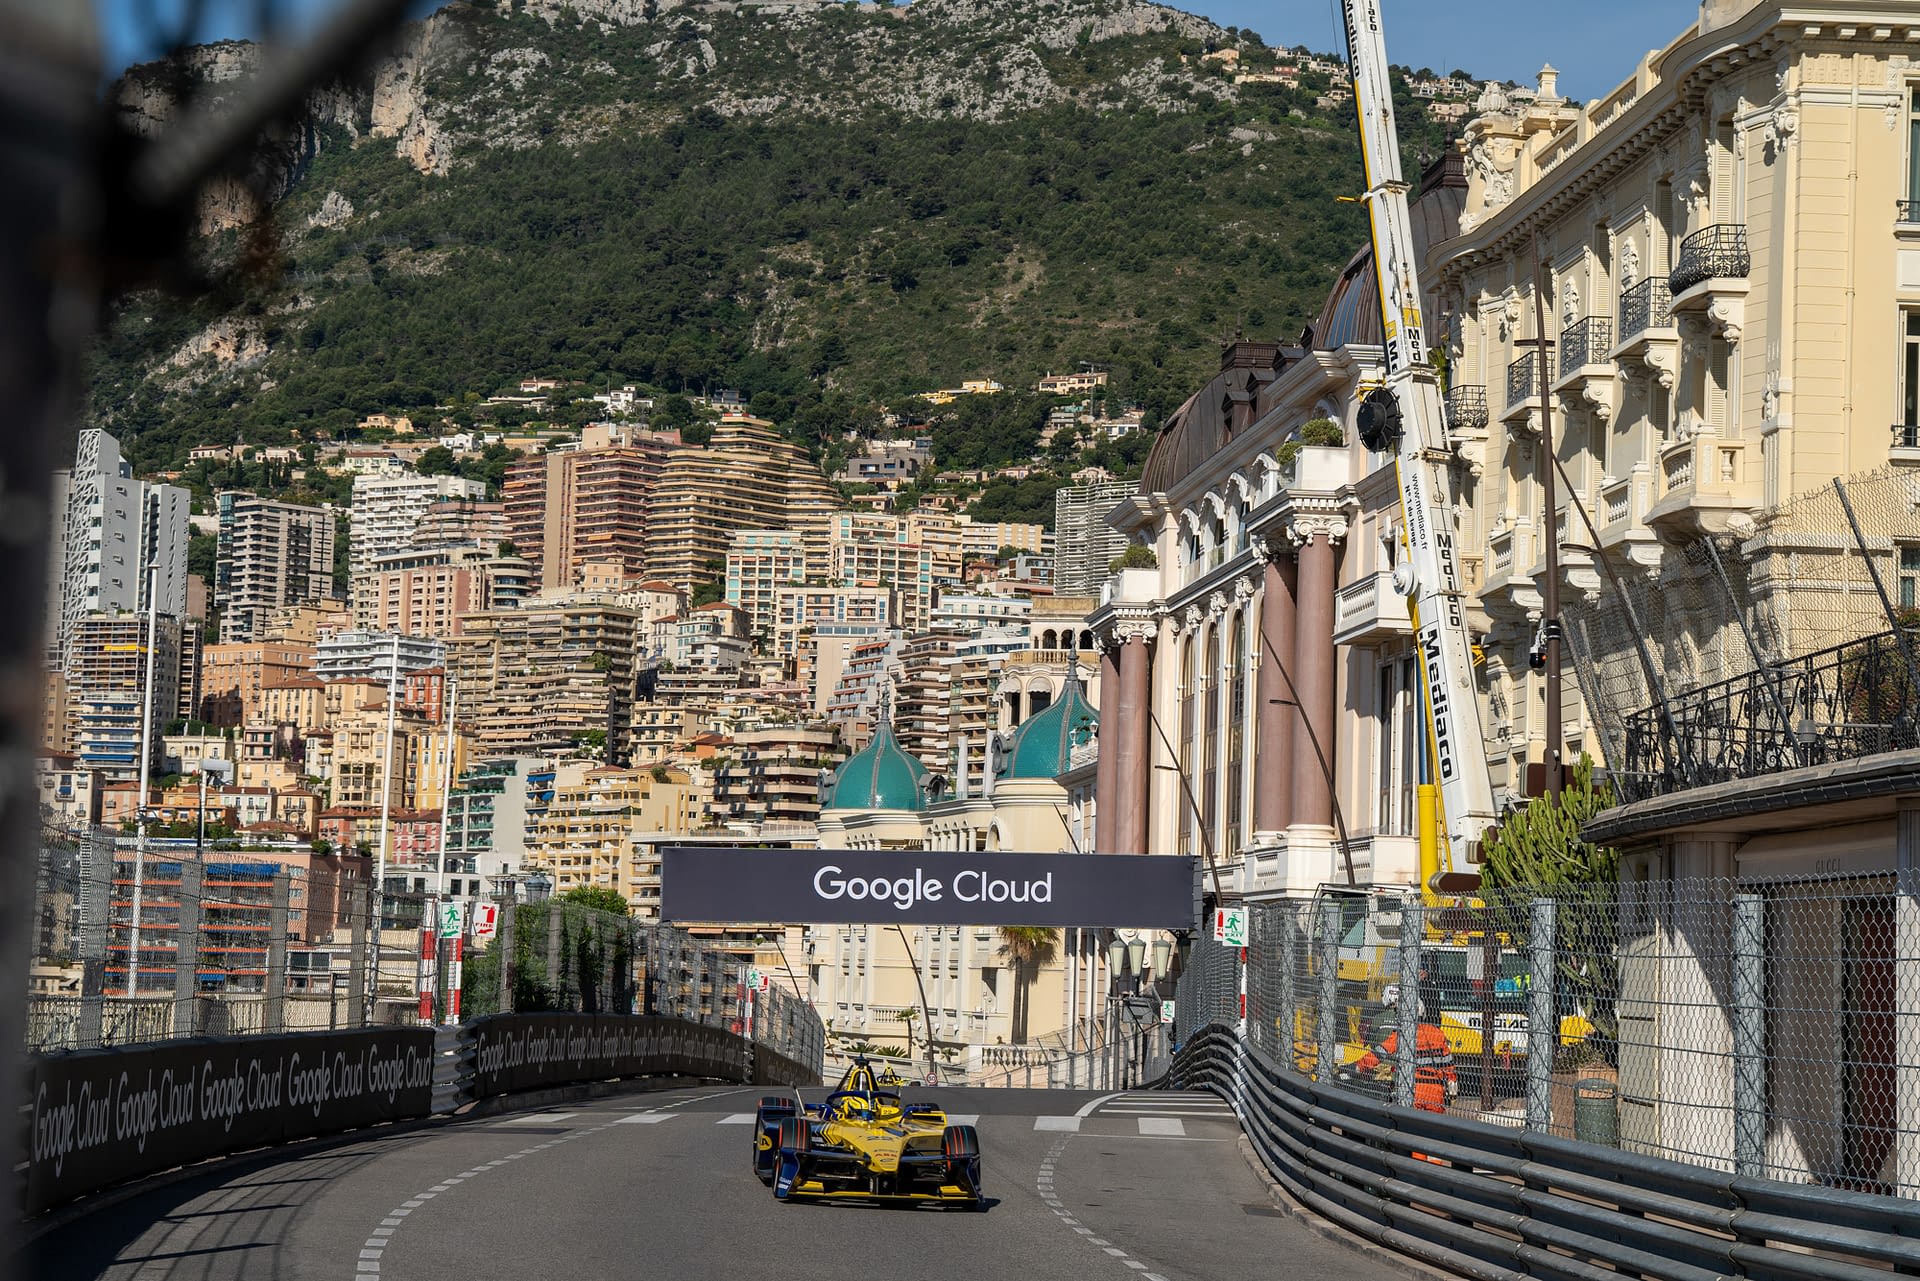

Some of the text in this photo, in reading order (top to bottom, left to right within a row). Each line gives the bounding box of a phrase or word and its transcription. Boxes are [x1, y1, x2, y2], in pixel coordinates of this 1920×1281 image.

[1409, 518, 1417, 547] levage
[1412, 473, 1428, 550] www.mediaco.fr
[1437, 534, 1460, 627] Mediaco
[1426, 629, 1452, 779] Mediaco
[813, 865, 1052, 910] Google Cloud
[478, 1030, 504, 1083] Google
[526, 1024, 549, 1074] Google
[33, 1043, 432, 1178] Google Cloud Google Cloud Google Cloud Google Cloud Google Cloud
